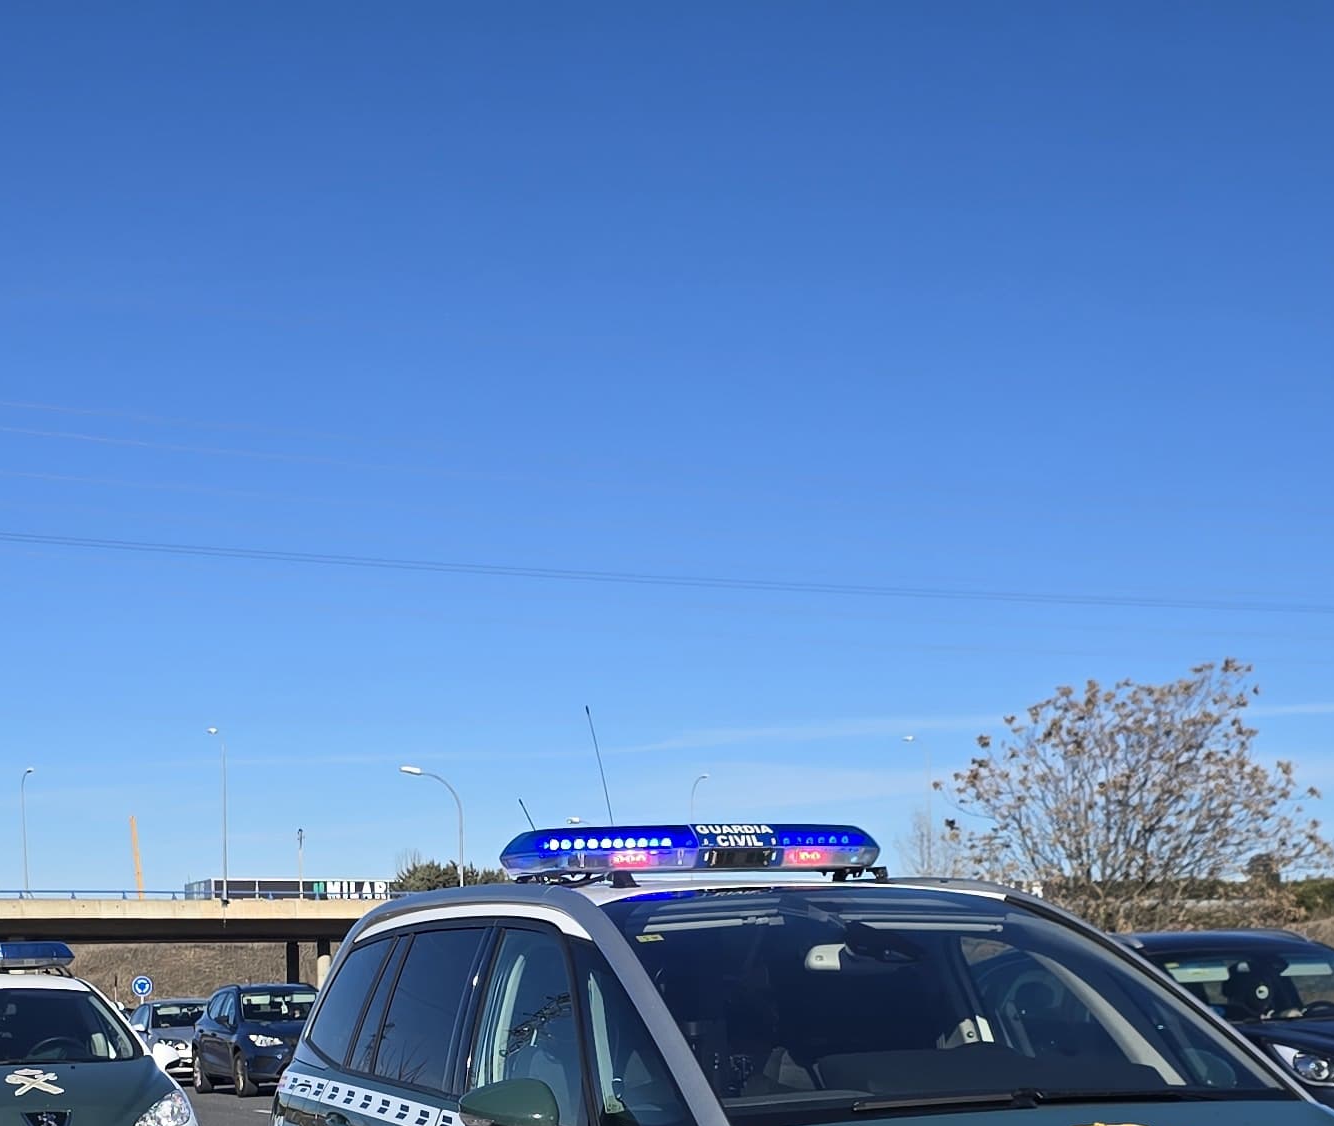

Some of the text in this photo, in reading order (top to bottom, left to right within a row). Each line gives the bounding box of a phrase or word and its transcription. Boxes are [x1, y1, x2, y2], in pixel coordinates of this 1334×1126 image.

[695, 825, 773, 834] GUARDIA
[716, 834, 763, 846] CIVIL
[326, 881, 387, 899] MILAR
